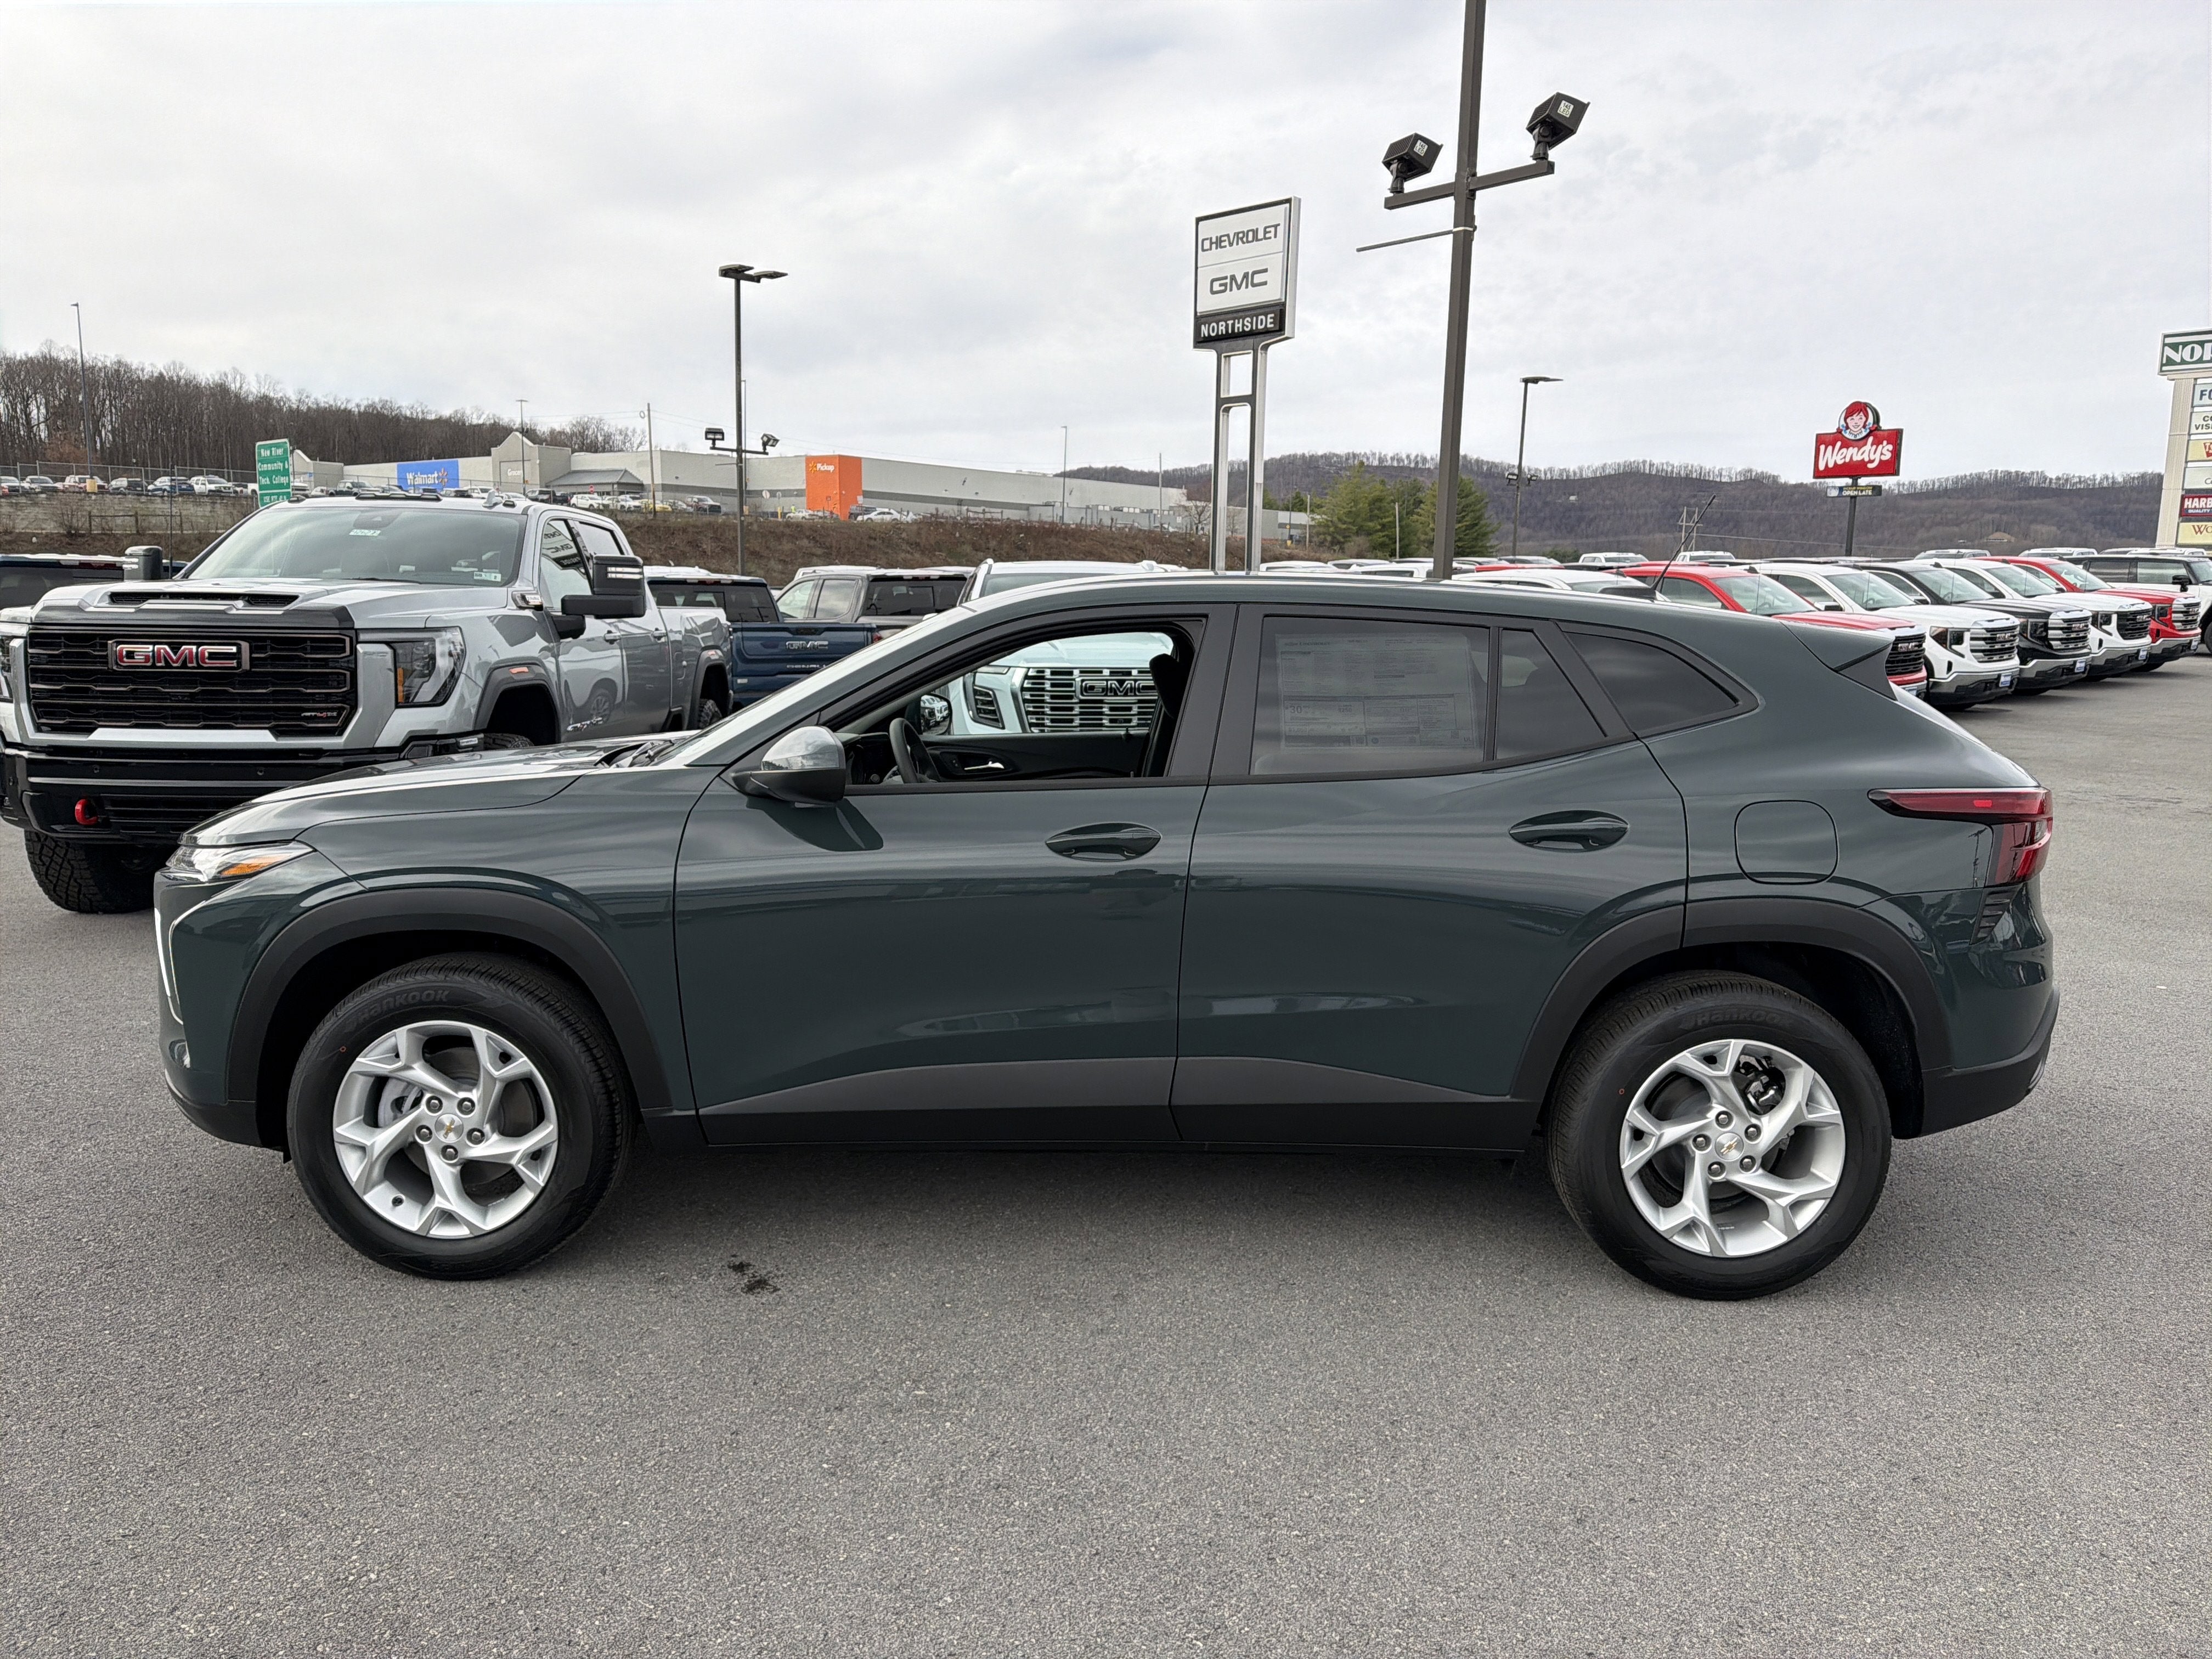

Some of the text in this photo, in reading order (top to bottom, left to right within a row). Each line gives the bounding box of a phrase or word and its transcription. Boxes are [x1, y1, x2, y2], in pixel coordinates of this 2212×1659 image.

[1201, 223, 1280, 252] CHEVROLET
[1210, 268, 1268, 295] GMC
[1201, 314, 1274, 337] NORTHSIDE
[261, 447, 284, 457] New River
[1819, 436, 1893, 471] Wendy's
[258, 461, 283, 471] Community
[816, 463, 834, 473] Pickup
[273, 475, 289, 486] College
[407, 471, 438, 485] Walmart
[786, 641, 828, 650] GMC
[117, 645, 237, 667] GMC
[1082, 681, 1158, 696] GMC
